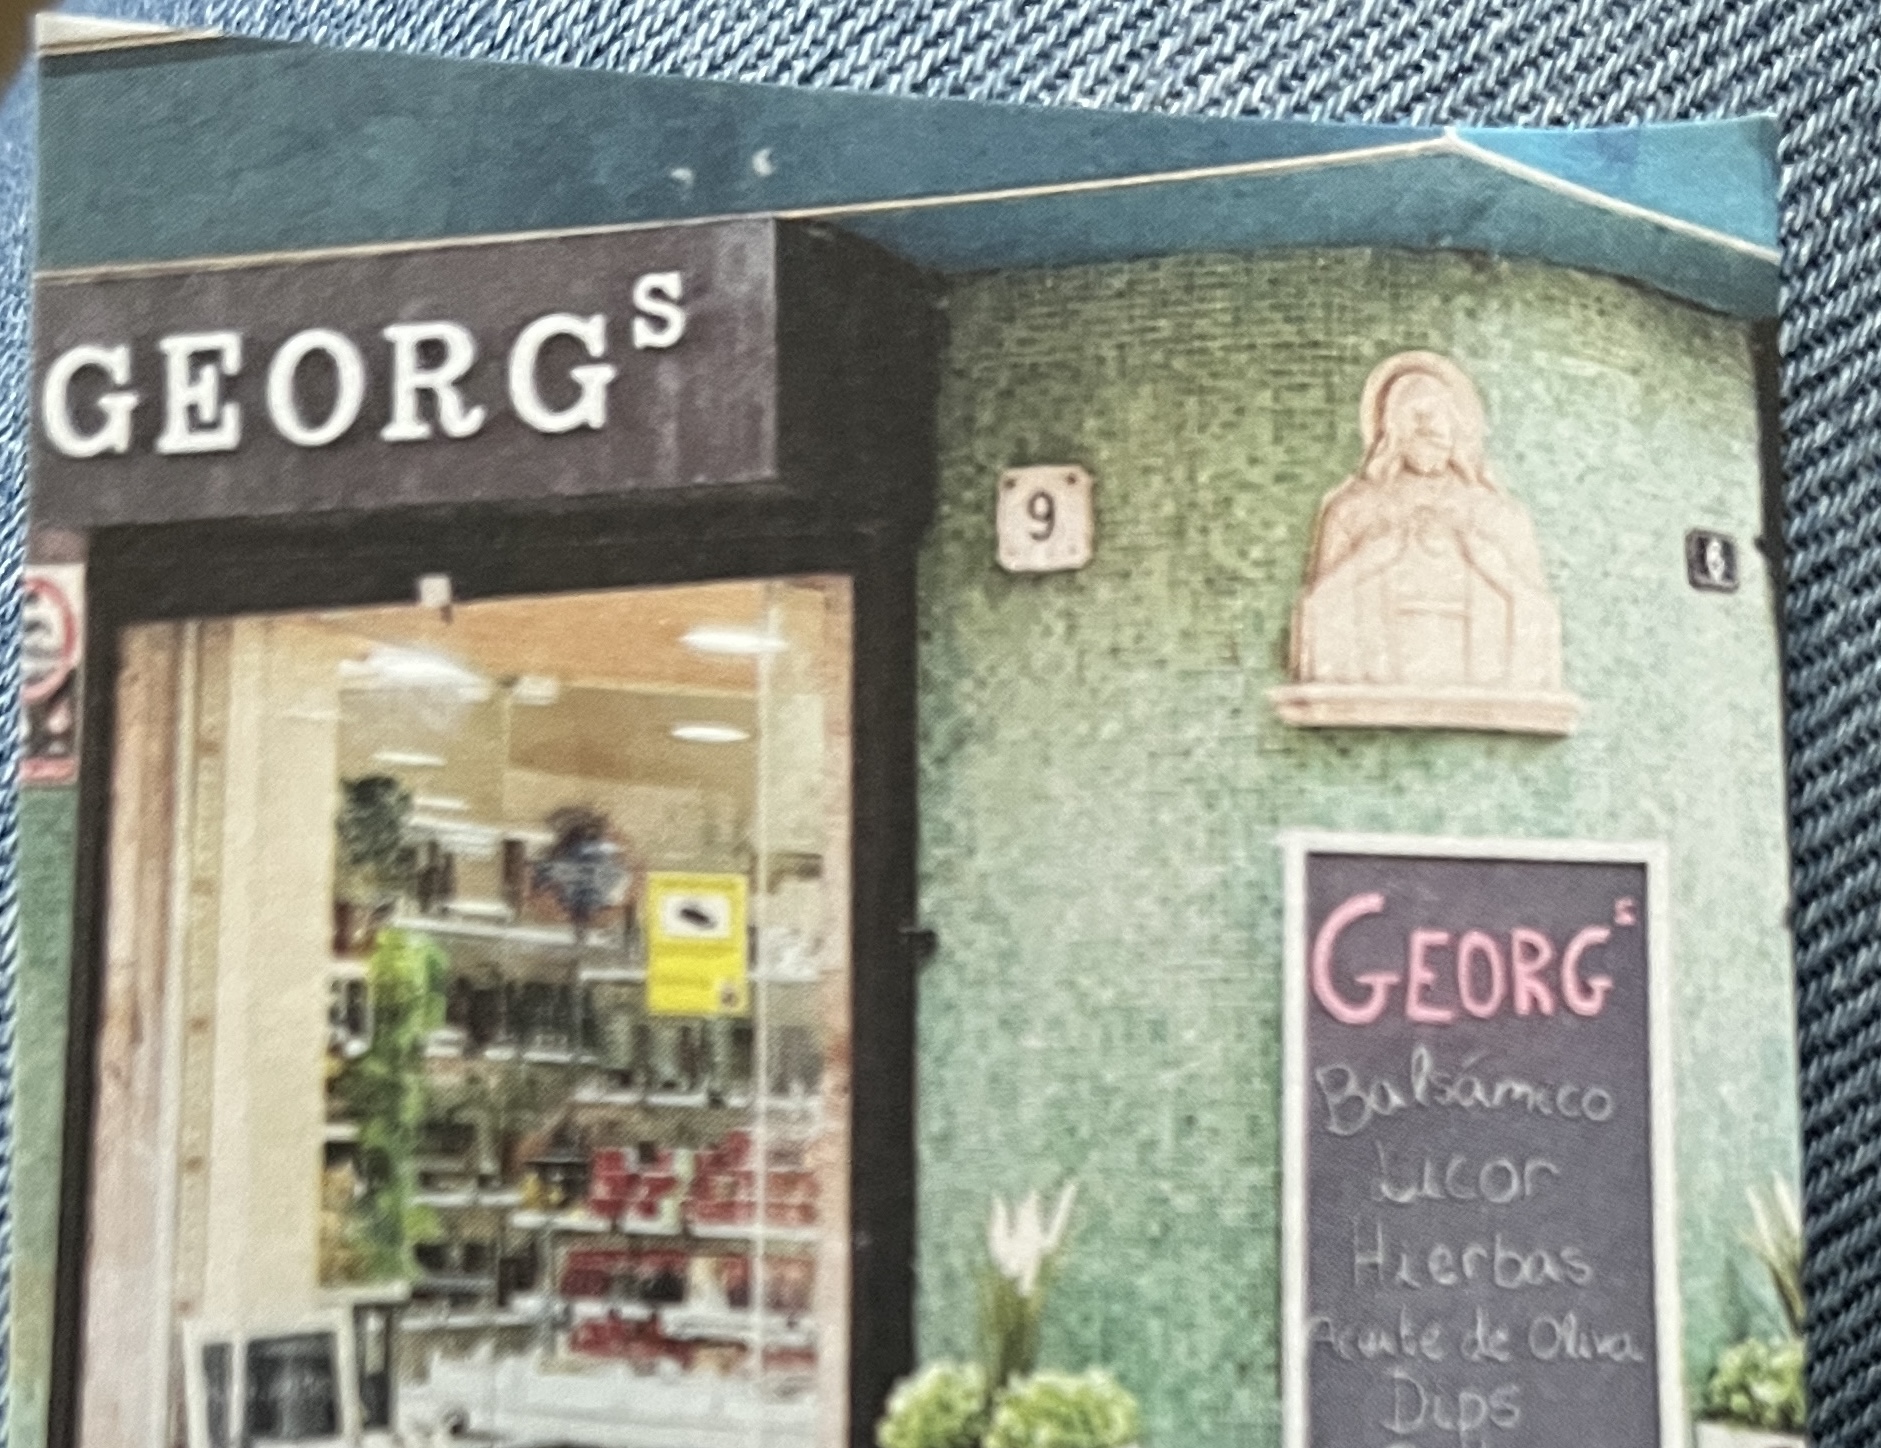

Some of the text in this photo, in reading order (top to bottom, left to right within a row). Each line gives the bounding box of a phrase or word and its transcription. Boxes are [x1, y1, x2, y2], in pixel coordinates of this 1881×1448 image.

[1026, 490, 1056, 541] 9
[1373, 1140, 1561, 1203] Licor
[1353, 1217, 1594, 1289] Hierbas
[1461, 1306, 1512, 1362] de
[1528, 1310, 1645, 1362] Oliva
